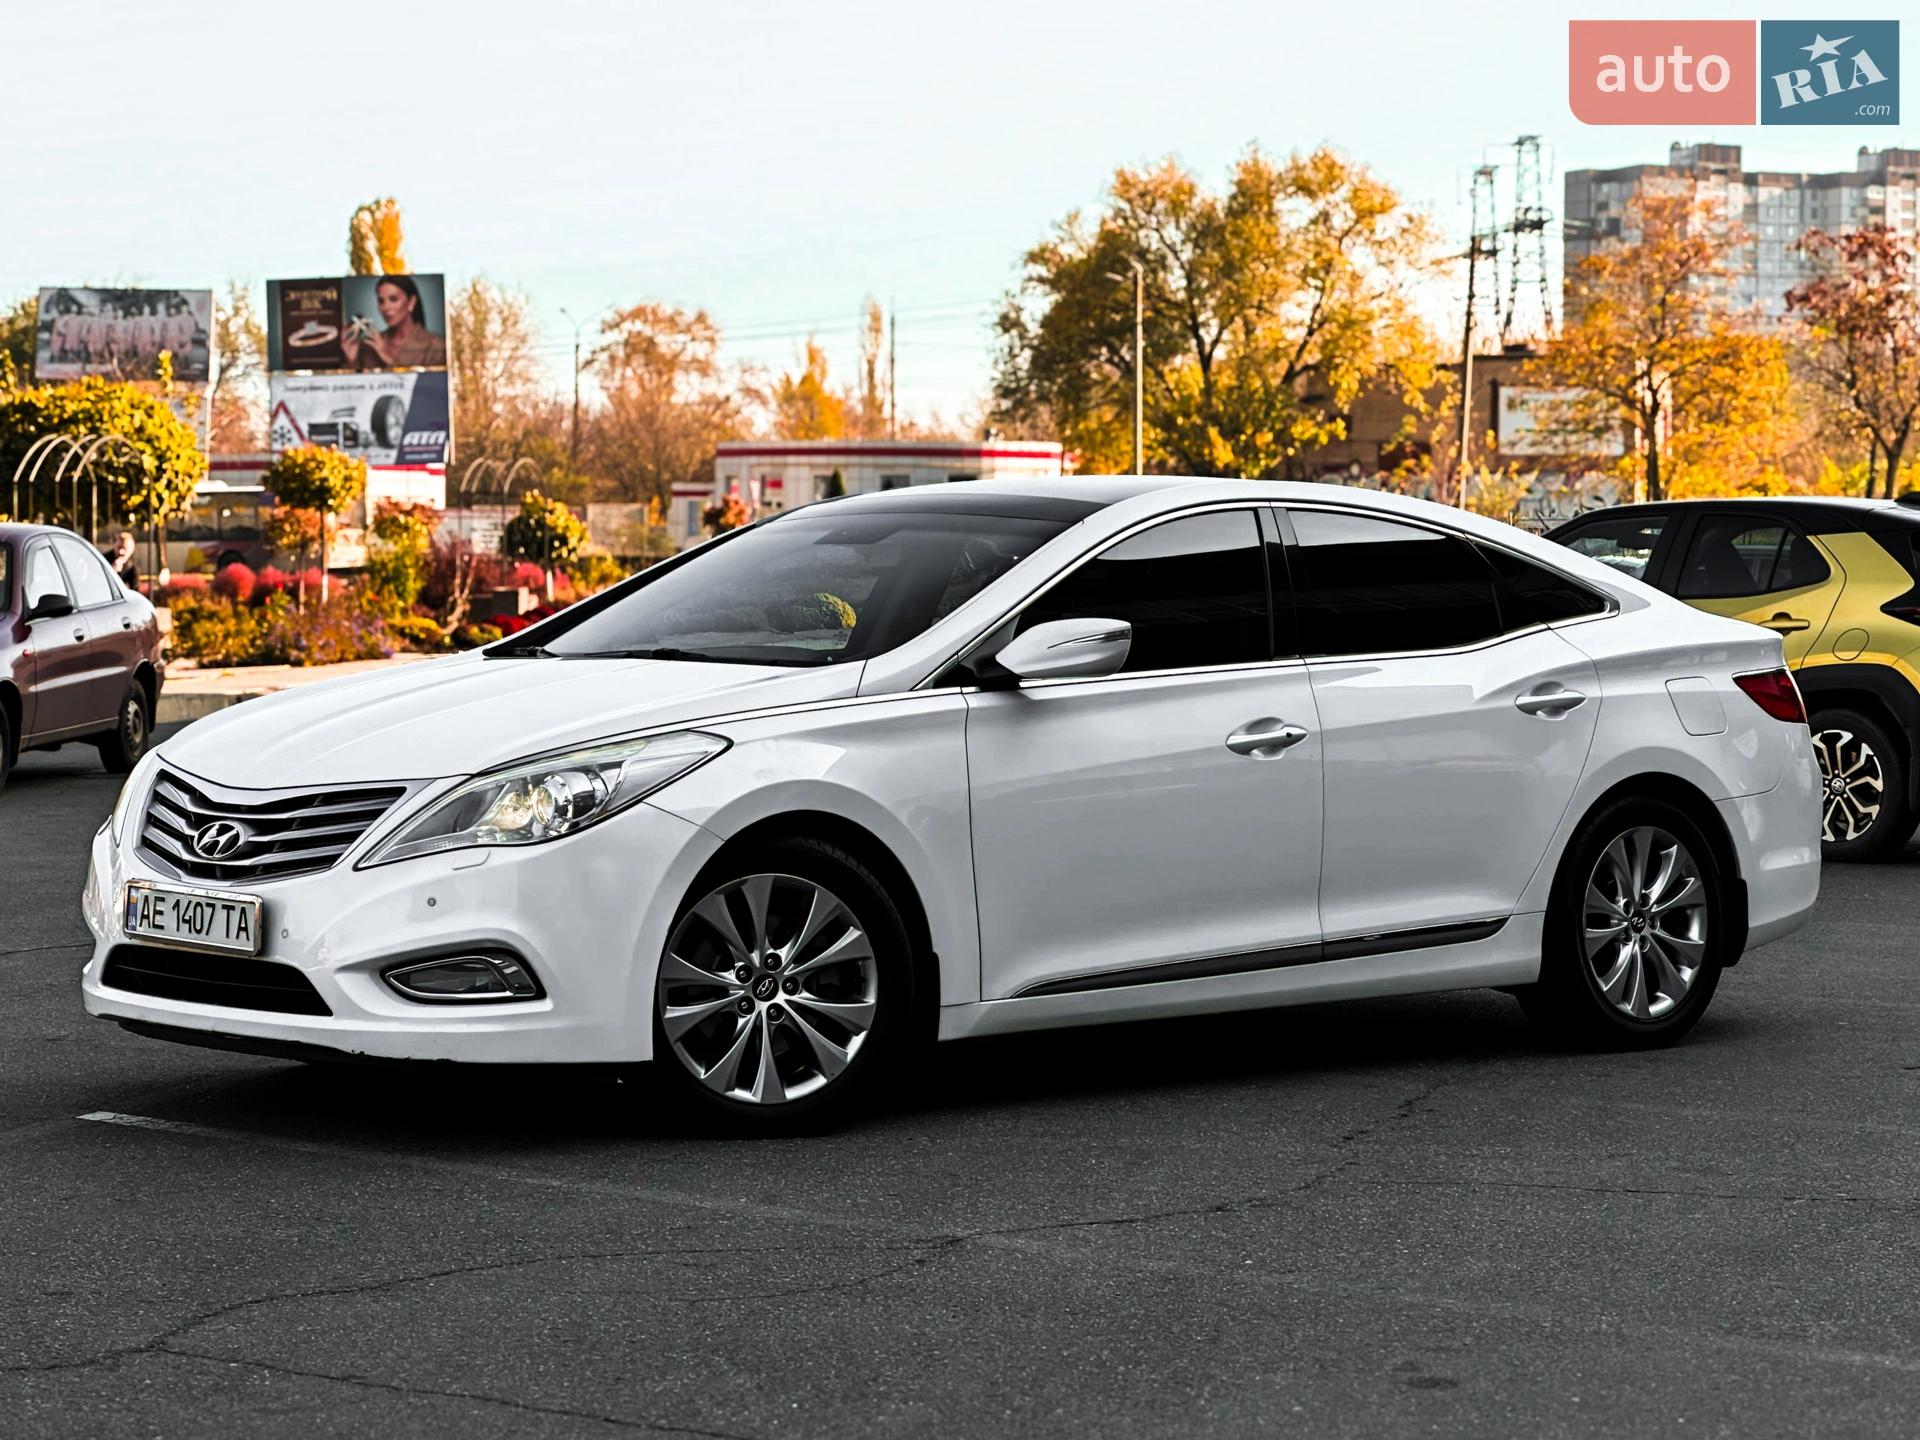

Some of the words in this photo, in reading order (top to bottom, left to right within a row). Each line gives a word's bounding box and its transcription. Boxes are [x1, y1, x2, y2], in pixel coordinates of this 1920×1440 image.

[139, 894, 166, 930] AE
[172, 898, 217, 936] 1407
[221, 904, 250, 941] TA
